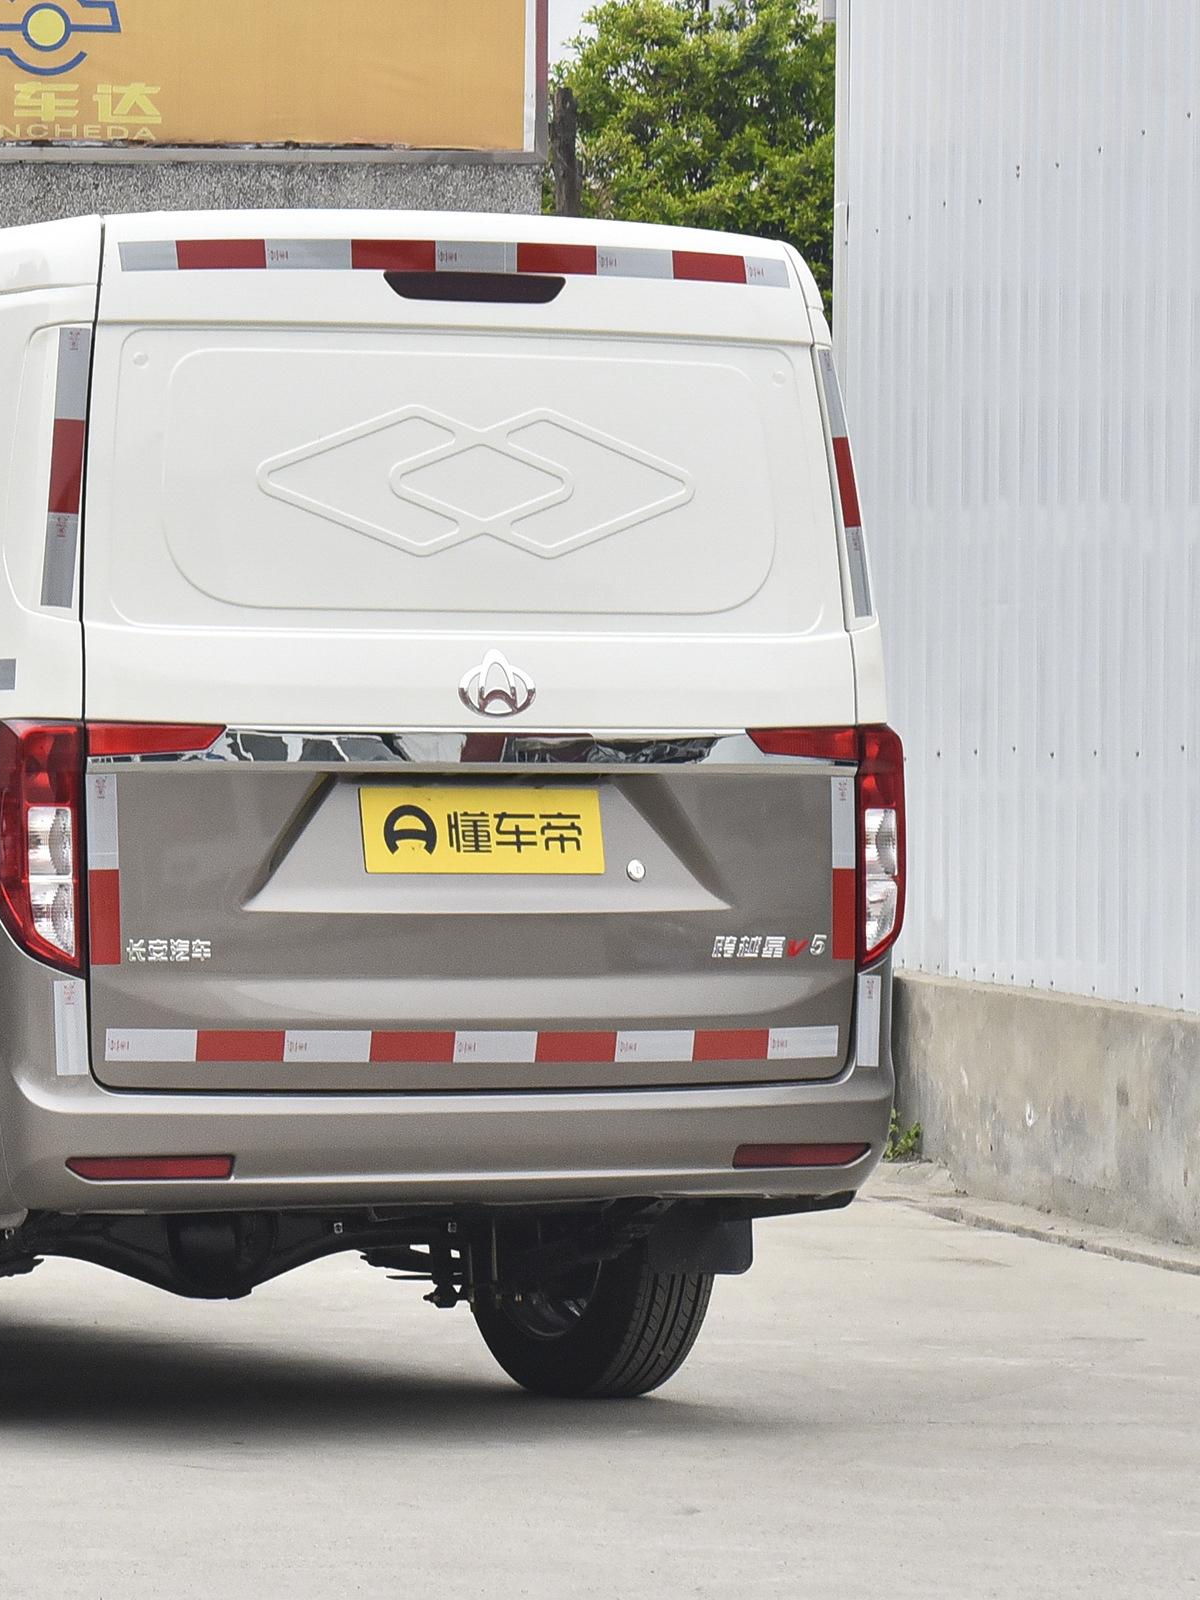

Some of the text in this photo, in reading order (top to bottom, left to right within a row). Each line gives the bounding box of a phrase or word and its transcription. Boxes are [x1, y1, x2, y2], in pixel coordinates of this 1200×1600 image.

[447, 811, 582, 853] 懂车帝
[125, 938, 212, 961] 长安汽车
